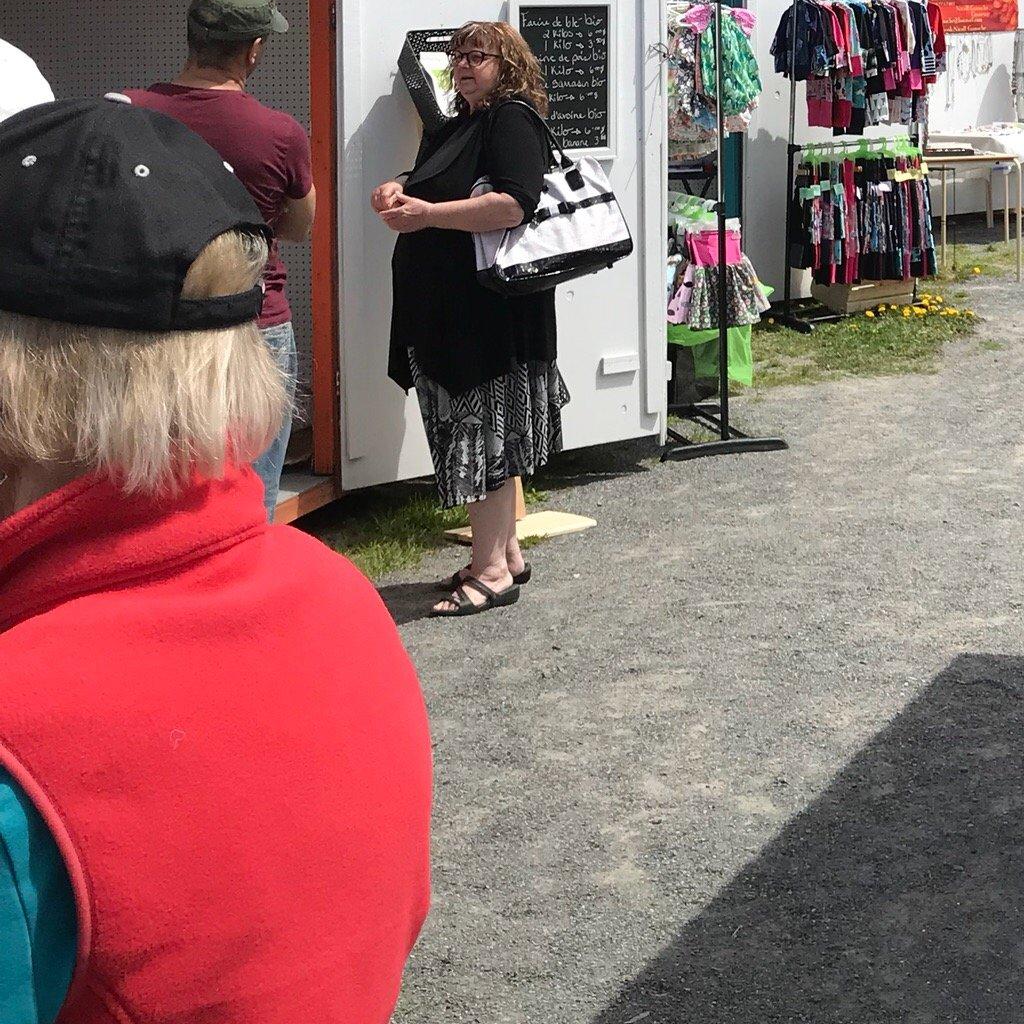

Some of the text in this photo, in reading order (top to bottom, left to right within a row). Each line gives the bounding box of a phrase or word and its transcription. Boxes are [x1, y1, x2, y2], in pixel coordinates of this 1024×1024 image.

[521, 11, 549, 28] Farine
[551, 16, 562, 28] de
[584, 13, 603, 26] bio
[542, 29, 550, 39] 2
[553, 39, 572, 50] Kilo
[558, 54, 570, 63] de
[592, 48, 606, 61] bio
[550, 65, 573, 76] Kilo
[591, 76, 606, 87] bio
[587, 108, 606, 119] bio
